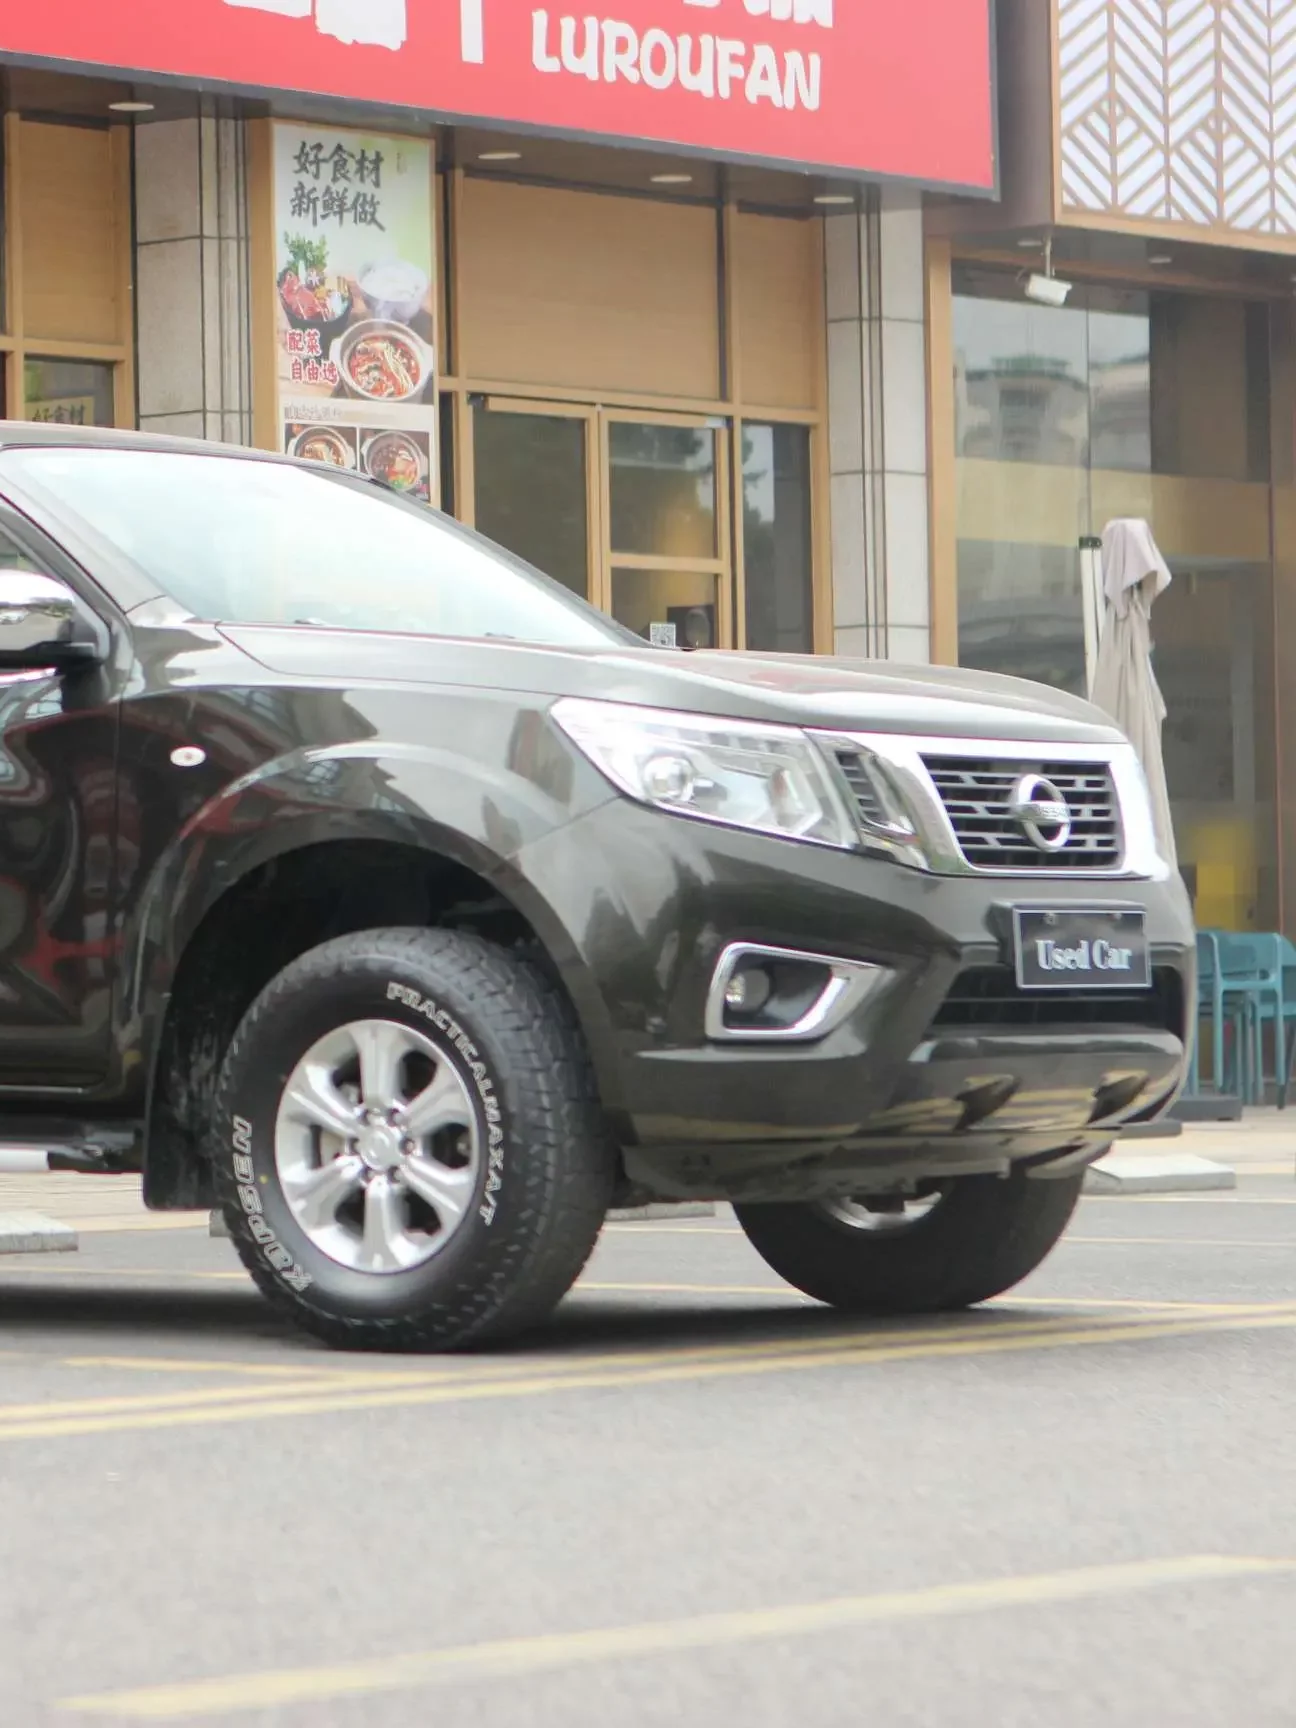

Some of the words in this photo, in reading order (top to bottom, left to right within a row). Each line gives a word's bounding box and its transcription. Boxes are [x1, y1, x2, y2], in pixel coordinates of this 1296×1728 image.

[532, 9, 822, 112] LUROUFAN
[292, 140, 385, 189] 好食材
[289, 180, 386, 232] 新鲜做
[287, 328, 322, 357] 配菜
[290, 356, 339, 386] 自由选
[1035, 939, 1092, 970] Used
[1092, 938, 1133, 970] Car
[231, 1114, 314, 1293] KAPSEN
